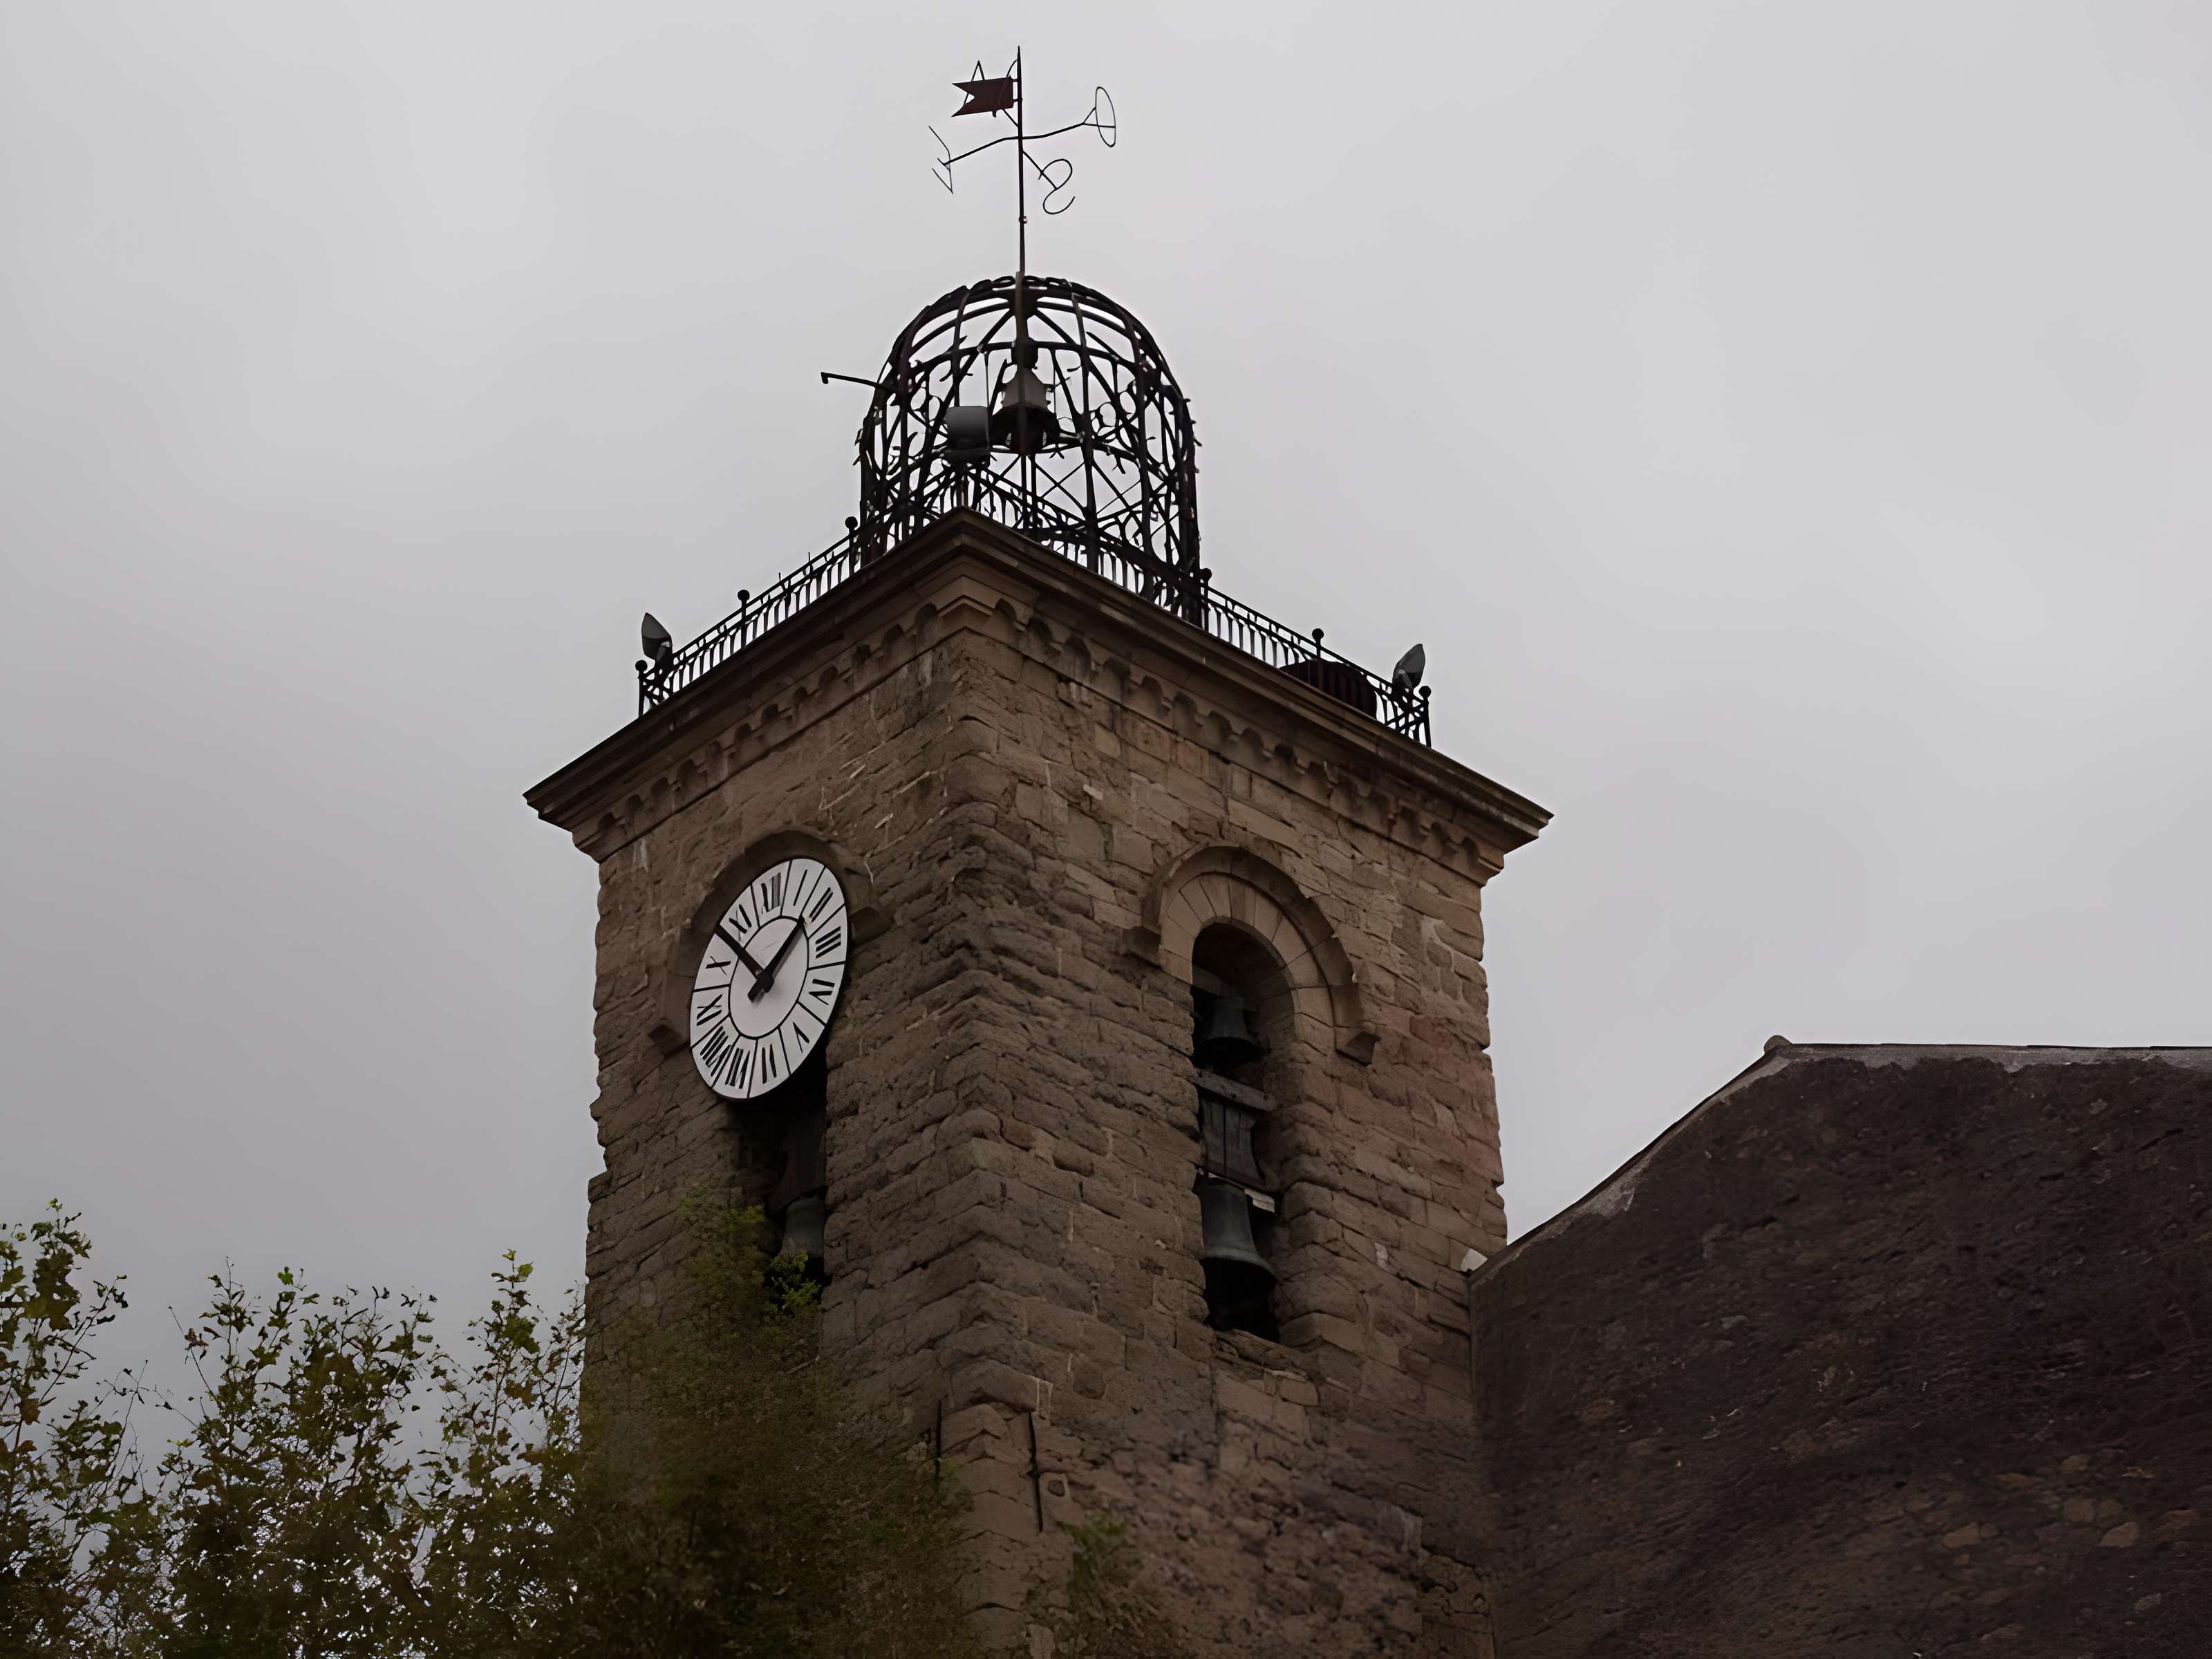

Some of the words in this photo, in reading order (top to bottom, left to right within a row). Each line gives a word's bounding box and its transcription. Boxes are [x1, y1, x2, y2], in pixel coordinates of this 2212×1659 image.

[794, 869, 808, 906] I
[809, 887, 834, 923] II
[815, 926, 841, 959] III
[705, 955, 731, 975] X
[808, 979, 836, 1006] IV
[696, 994, 723, 1027] IX
[793, 1022, 810, 1053] V
